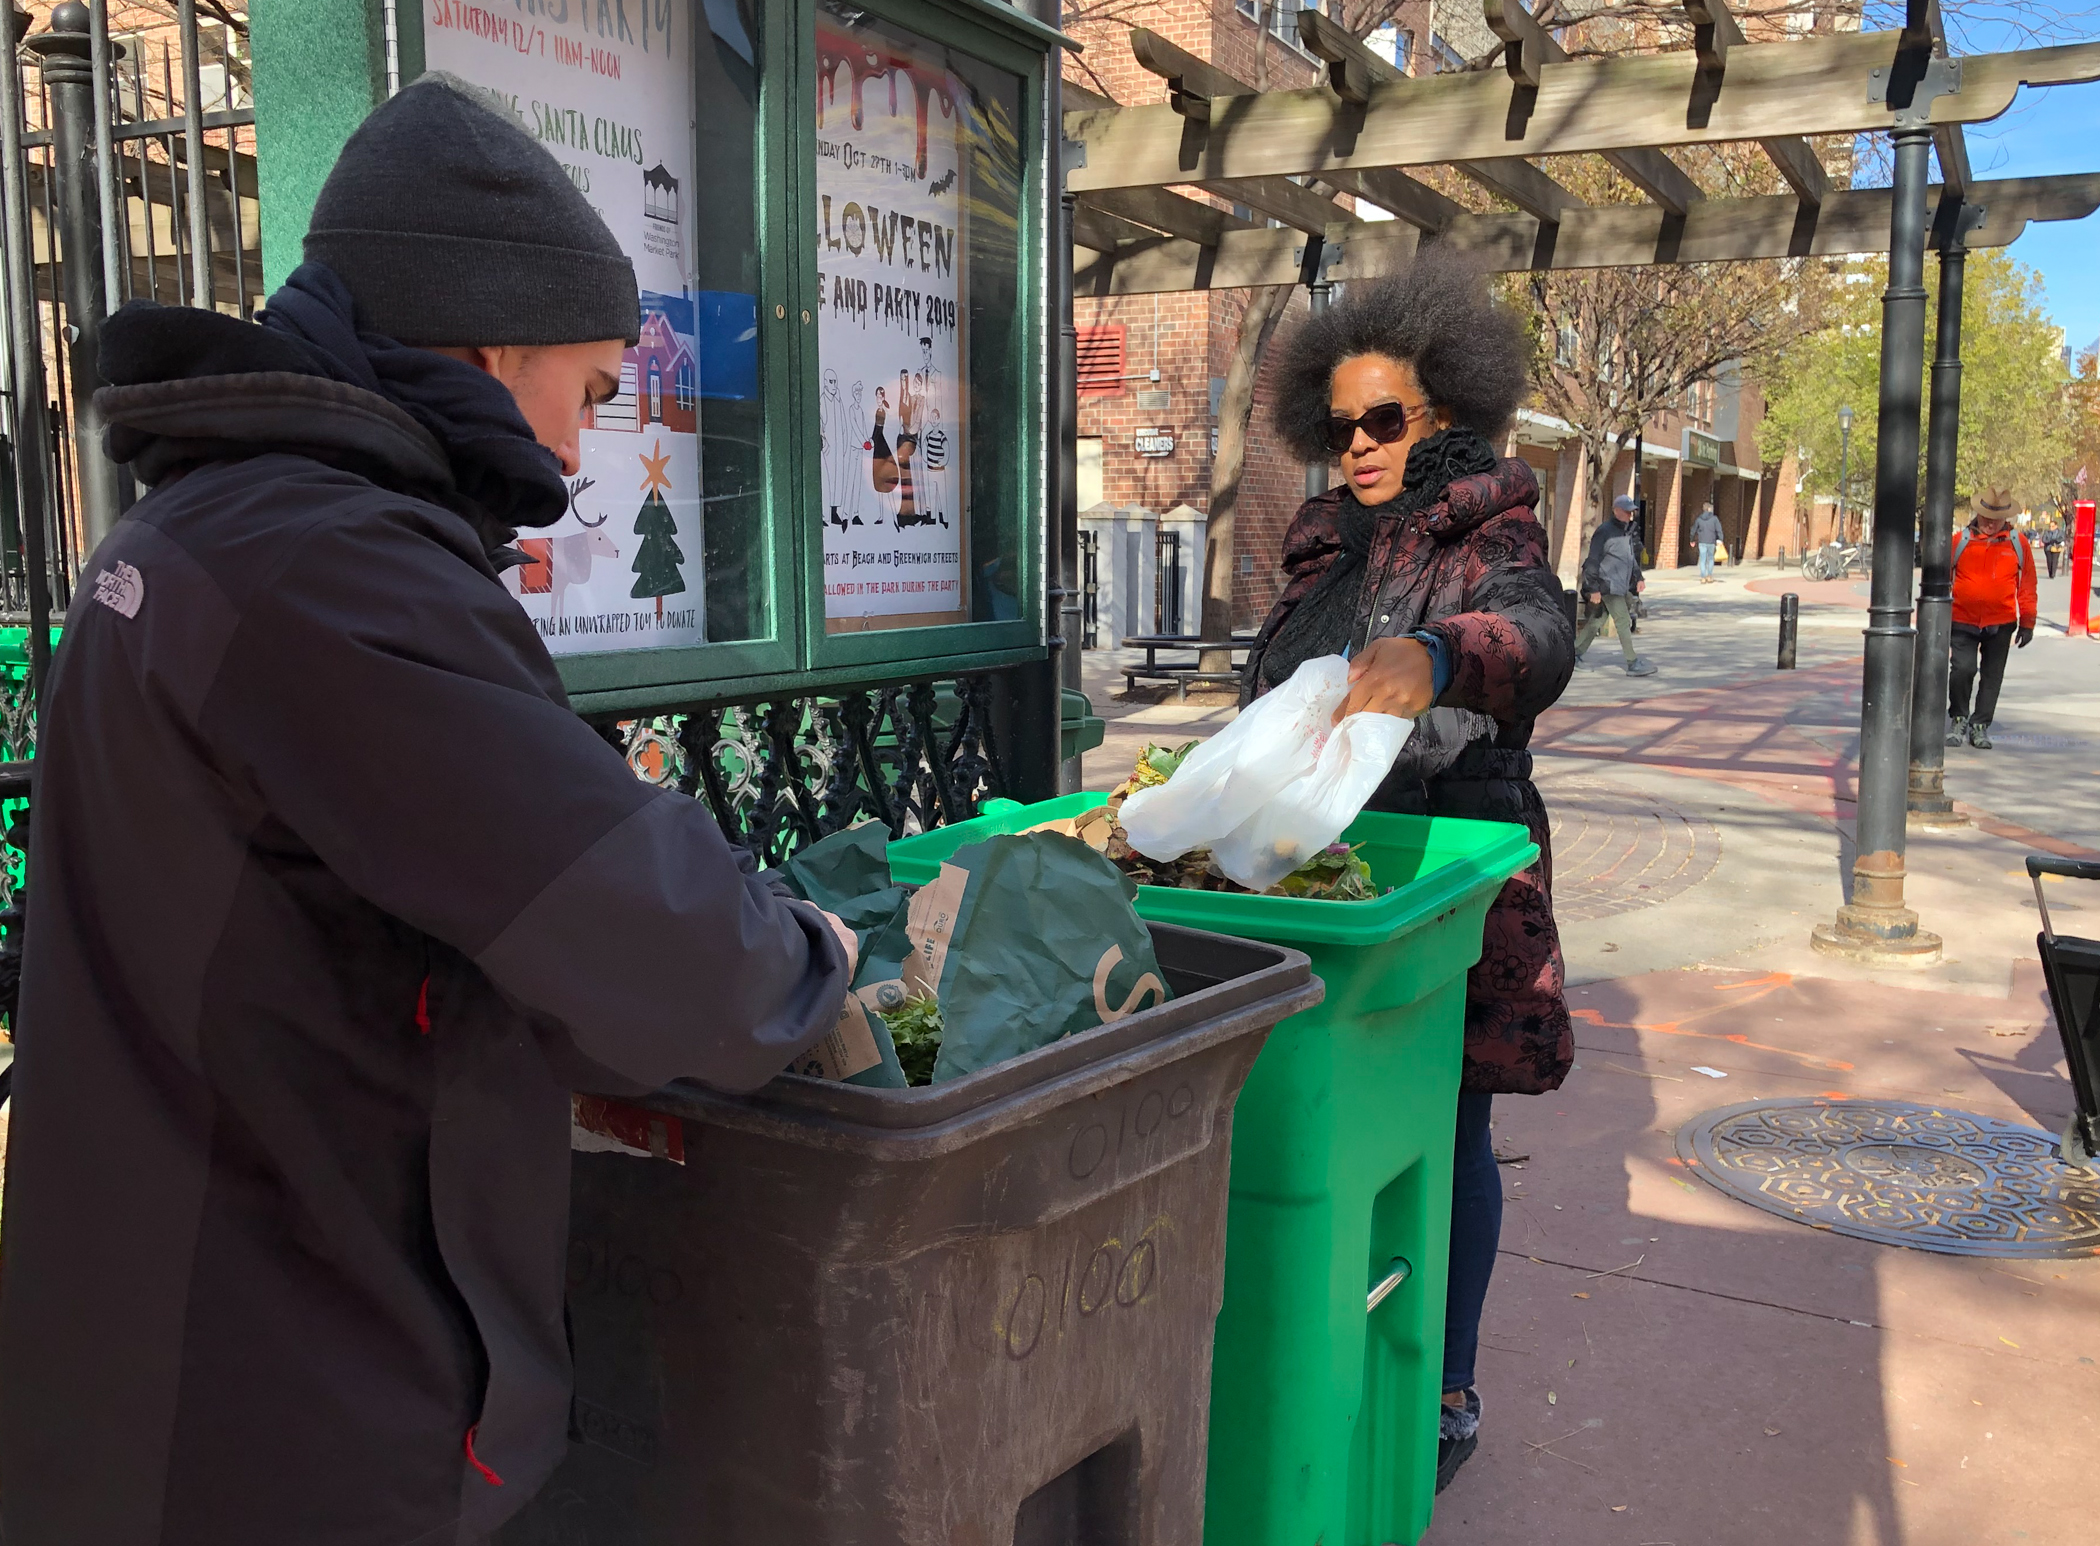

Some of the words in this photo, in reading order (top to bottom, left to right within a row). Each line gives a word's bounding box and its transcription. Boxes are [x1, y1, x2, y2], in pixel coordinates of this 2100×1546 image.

[433, 0, 508, 46] SATURDAY
[512, 20, 545, 57] 12/7
[532, 100, 589, 151] SANTA
[594, 117, 643, 165] CLAUS
[816, 139, 840, 161] NDAY
[643, 230, 680, 248] Washington
[817, 194, 954, 279] LOWEEN
[643, 242, 665, 257] Market
[666, 247, 680, 260] Park
[833, 275, 867, 330] AND
[873, 283, 920, 338] PARTY
[926, 295, 956, 343] 2019
[1135, 436, 1174, 452] CLEANERS
[841, 552, 850, 565] AT
[877, 552, 892, 564] AND
[933, 552, 958, 564] STREETS
[114, 560, 134, 581] THE
[95, 569, 129, 596] NORTH
[824, 583, 855, 596] ALLOWED
[857, 582, 864, 595] IN
[866, 582, 879, 594] THE
[881, 581, 900, 595] PARK
[901, 580, 925, 594] DURING
[927, 580, 939, 592] THE
[940, 579, 959, 592] PARTY
[92, 586, 121, 609] FACE
[531, 617, 556, 637] RING
[559, 616, 571, 636] AN
[575, 614, 631, 634] UNWRAPPED
[634, 612, 651, 630] TOY
[654, 611, 665, 630] TO
[667, 609, 696, 629] DONATE
